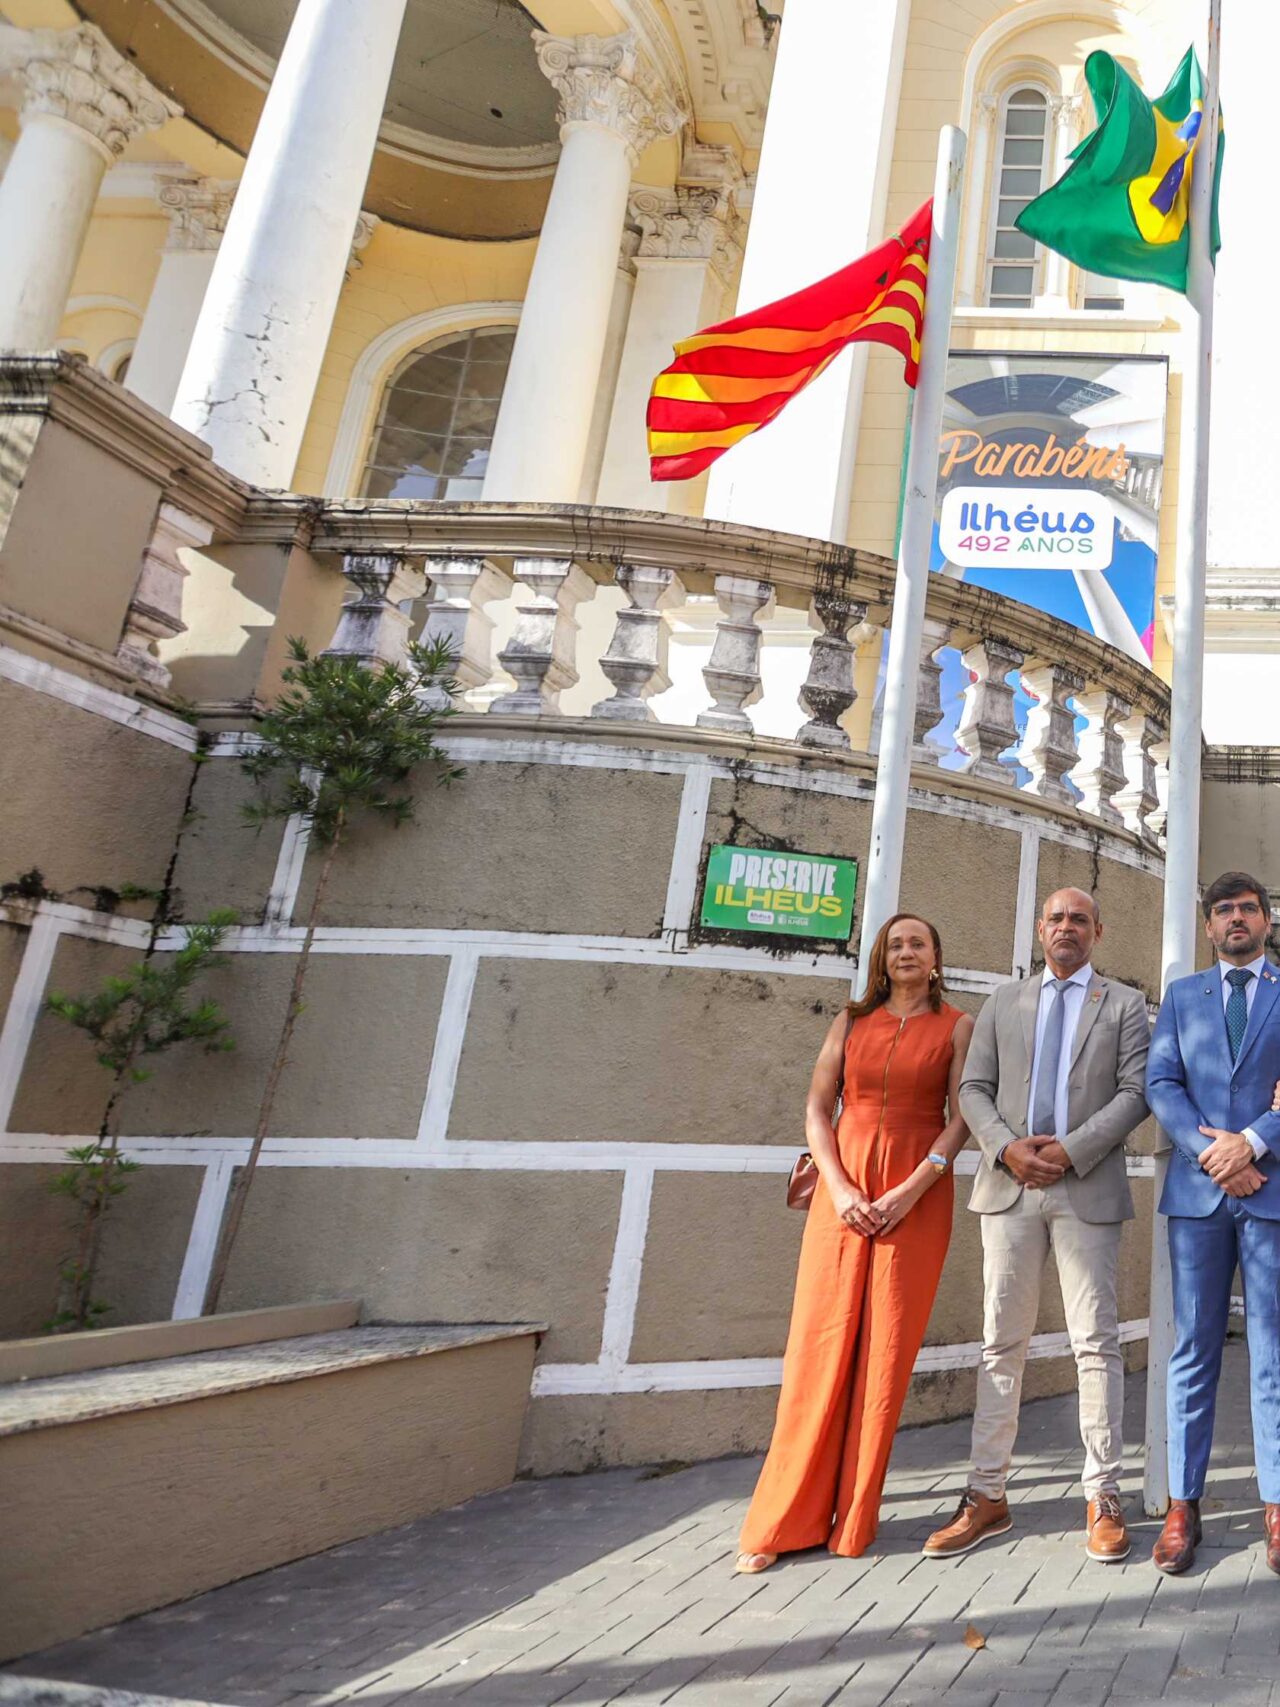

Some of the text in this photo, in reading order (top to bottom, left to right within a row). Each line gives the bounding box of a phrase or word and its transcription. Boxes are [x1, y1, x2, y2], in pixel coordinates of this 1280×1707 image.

[939, 430, 1130, 480] Parabéns
[960, 502, 1095, 534] Ilhéus
[958, 535, 1093, 553] 492 ANOS
[728, 853, 837, 896] PRESERVE
